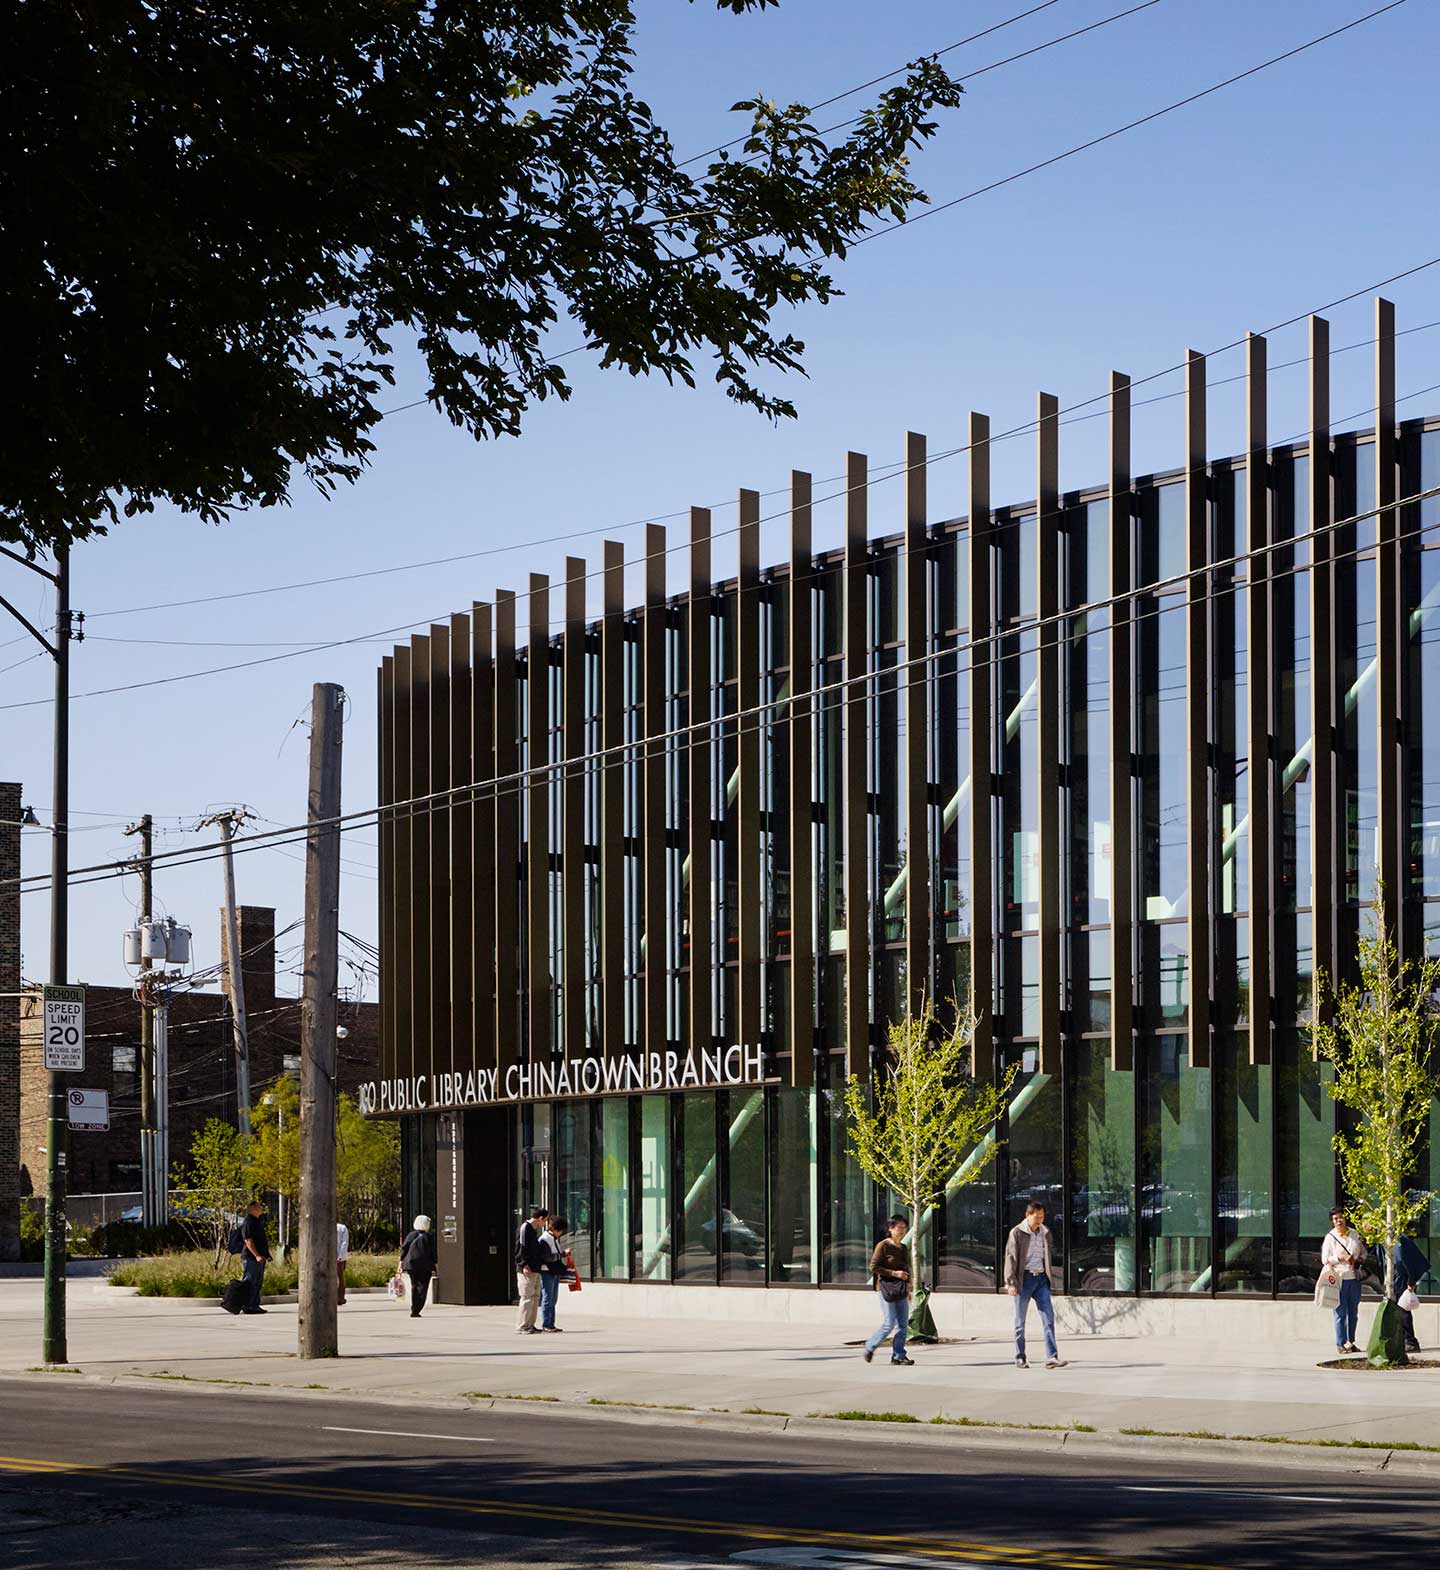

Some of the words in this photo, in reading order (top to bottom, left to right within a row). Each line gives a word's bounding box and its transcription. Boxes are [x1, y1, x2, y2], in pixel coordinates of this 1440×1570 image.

[46, 989, 81, 1000] SCHOOL
[47, 1003, 80, 1014] SPEED
[51, 1015, 77, 1024] LIMIT
[49, 1026, 79, 1045] 20
[381, 1076, 426, 1111] PUBLIC
[432, 1067, 499, 1107] LIBRARY
[505, 1053, 645, 1099] CHINATOWN
[650, 1043, 762, 1089] BRANCH
